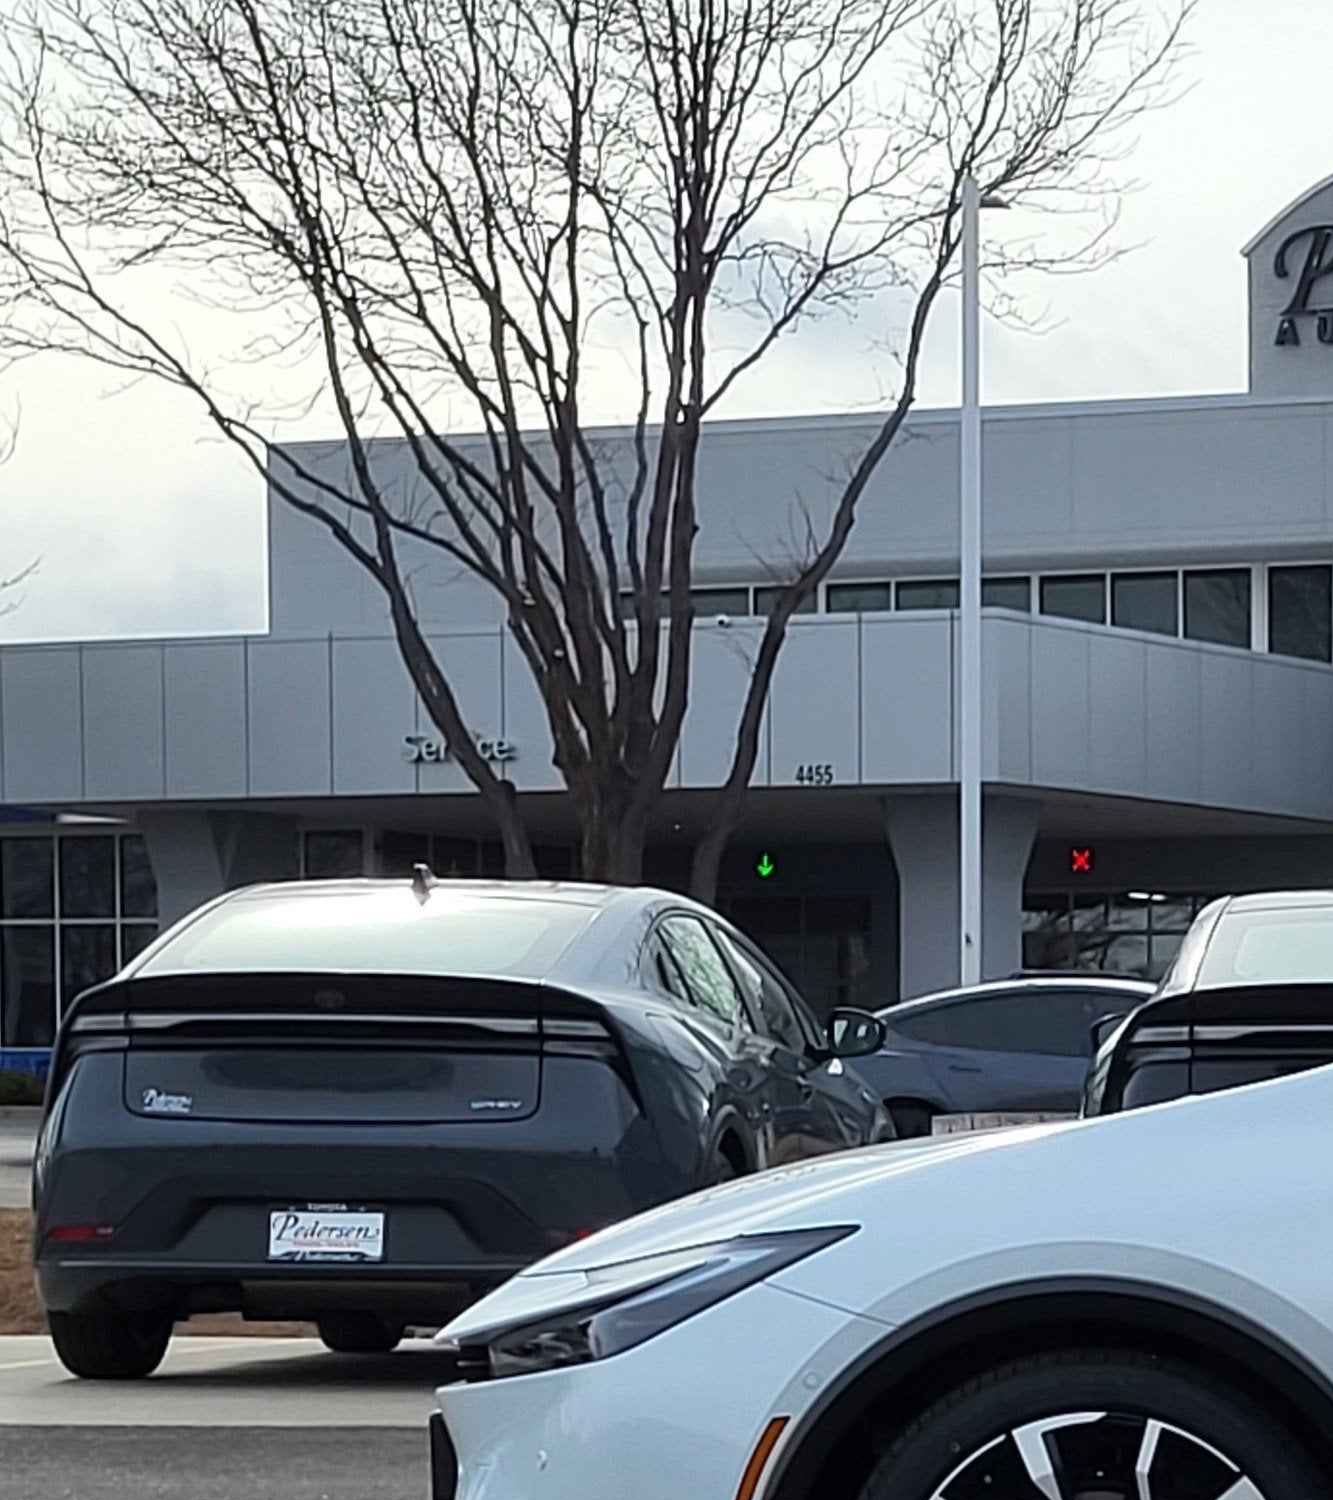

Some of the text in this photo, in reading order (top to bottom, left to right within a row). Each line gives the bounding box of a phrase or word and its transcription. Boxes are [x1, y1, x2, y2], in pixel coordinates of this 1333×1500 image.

[402, 734, 518, 763] Serce
[795, 764, 834, 785] 4455
[272, 1213, 381, 1242] Pedersen
